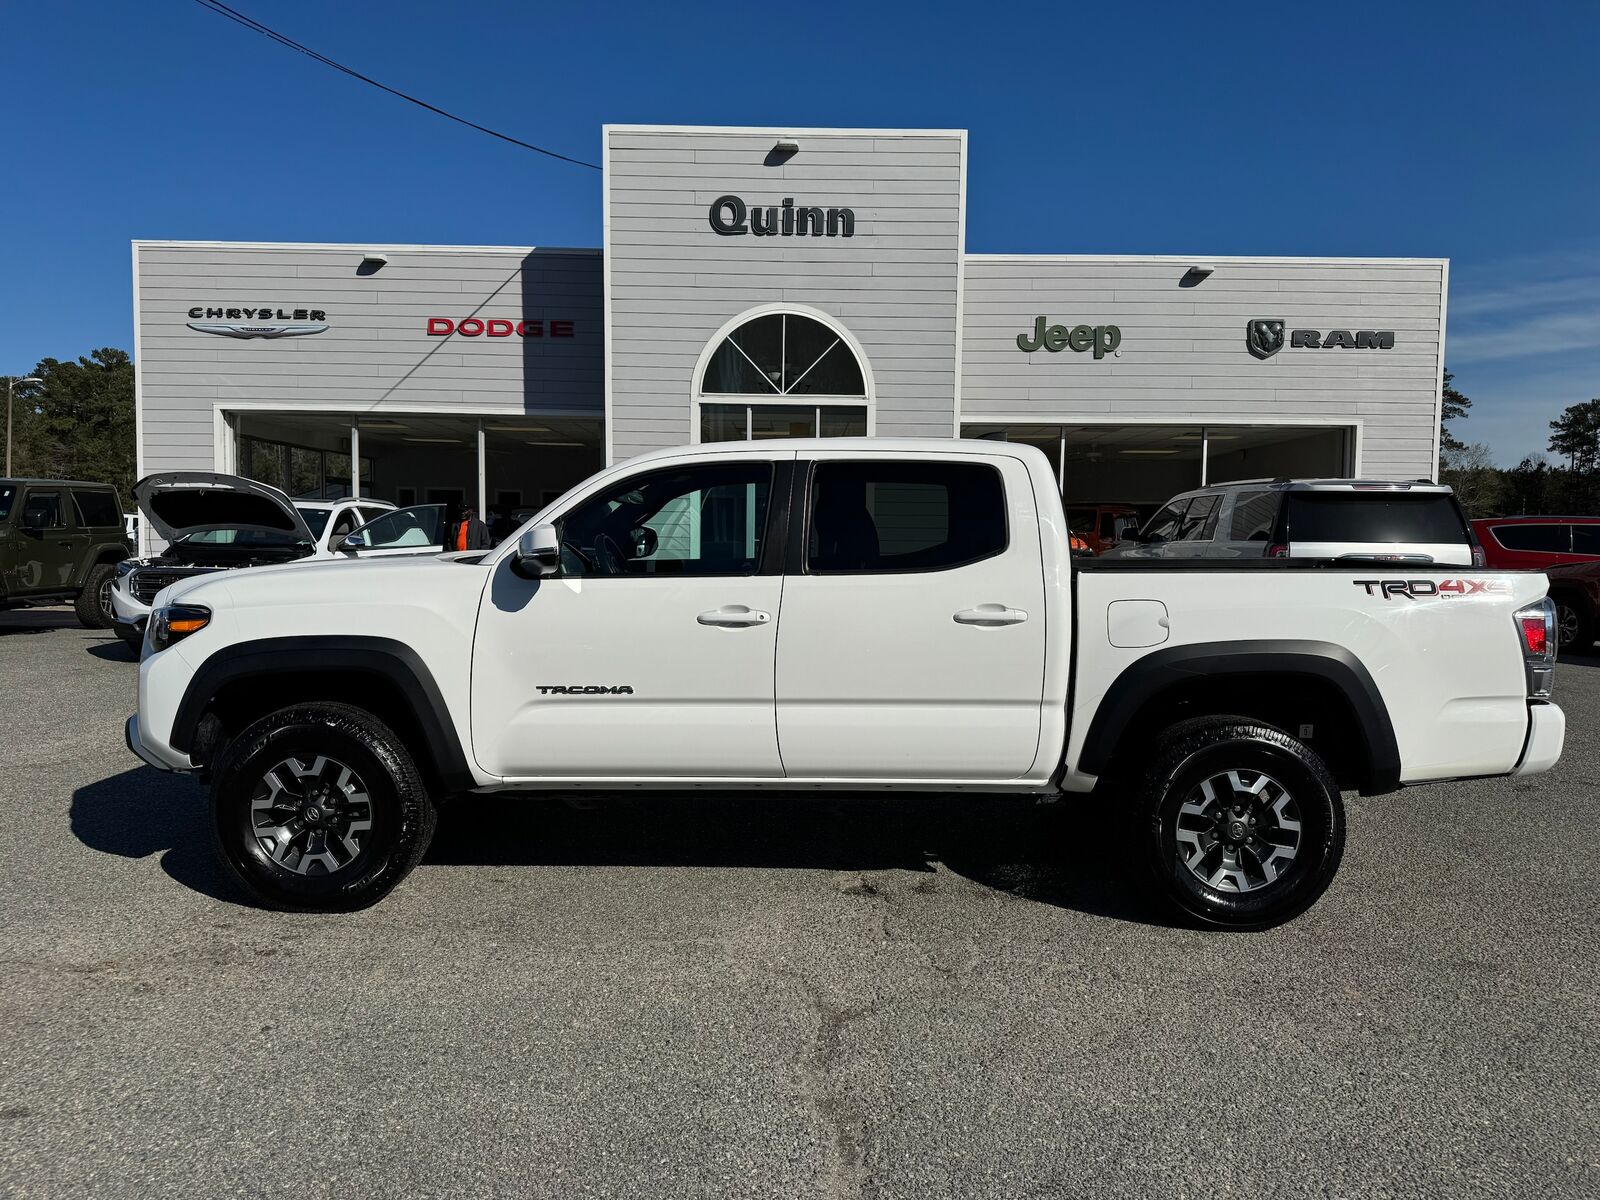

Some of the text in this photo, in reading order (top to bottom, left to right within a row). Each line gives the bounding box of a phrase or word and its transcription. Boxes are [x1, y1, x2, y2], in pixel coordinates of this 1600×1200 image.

[709, 195, 855, 237] Quinn
[188, 307, 326, 321] CHRYSLER
[427, 318, 575, 337] DODGE
[1016, 316, 1121, 360] Jeep
[1291, 330, 1395, 349] RAM
[535, 685, 634, 695] TACOMA
